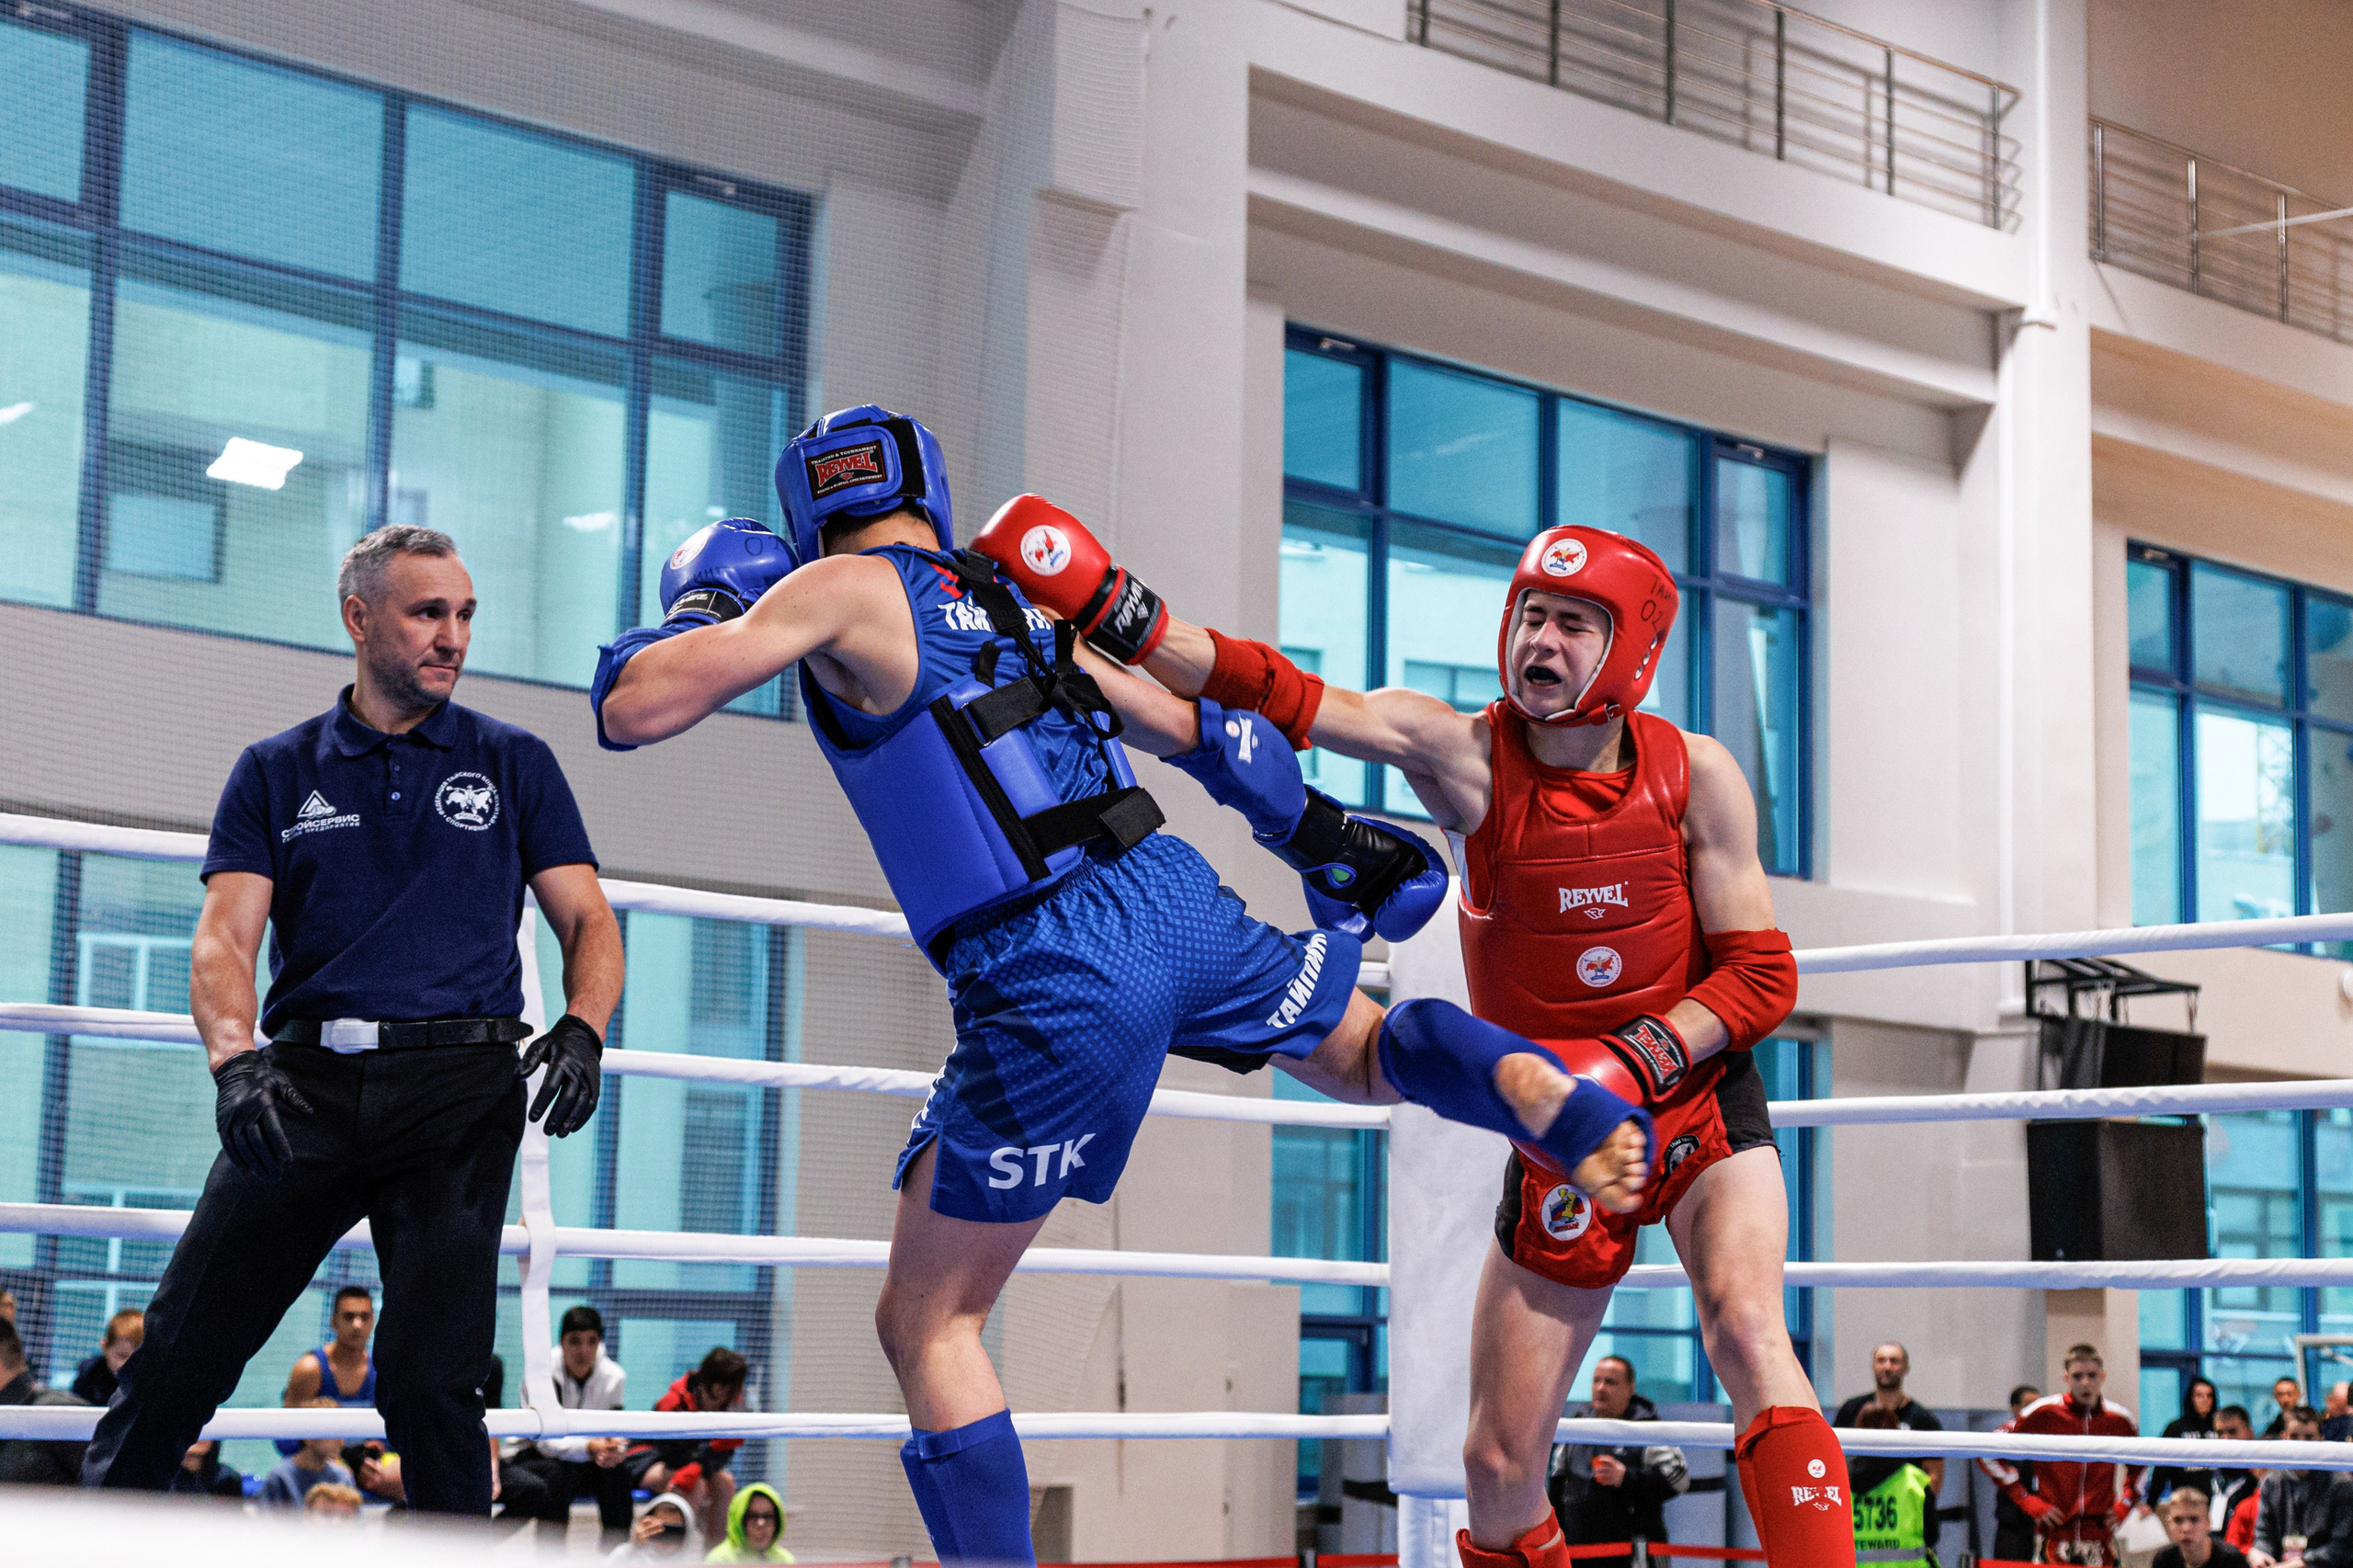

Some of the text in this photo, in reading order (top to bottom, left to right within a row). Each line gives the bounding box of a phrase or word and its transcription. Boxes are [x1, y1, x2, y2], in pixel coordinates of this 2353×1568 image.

[811, 454, 835, 464] TRAINING
[840, 445, 877, 455] TOURNAMENT
[815, 451, 878, 487] REYVEL
[1558, 882, 1629, 914] REYVEL
[988, 1132, 1097, 1189] STK
[1790, 1485, 1842, 1507] REEL
[1854, 1495, 1898, 1532] 5736
[1854, 1539, 1901, 1551] TEWARD
